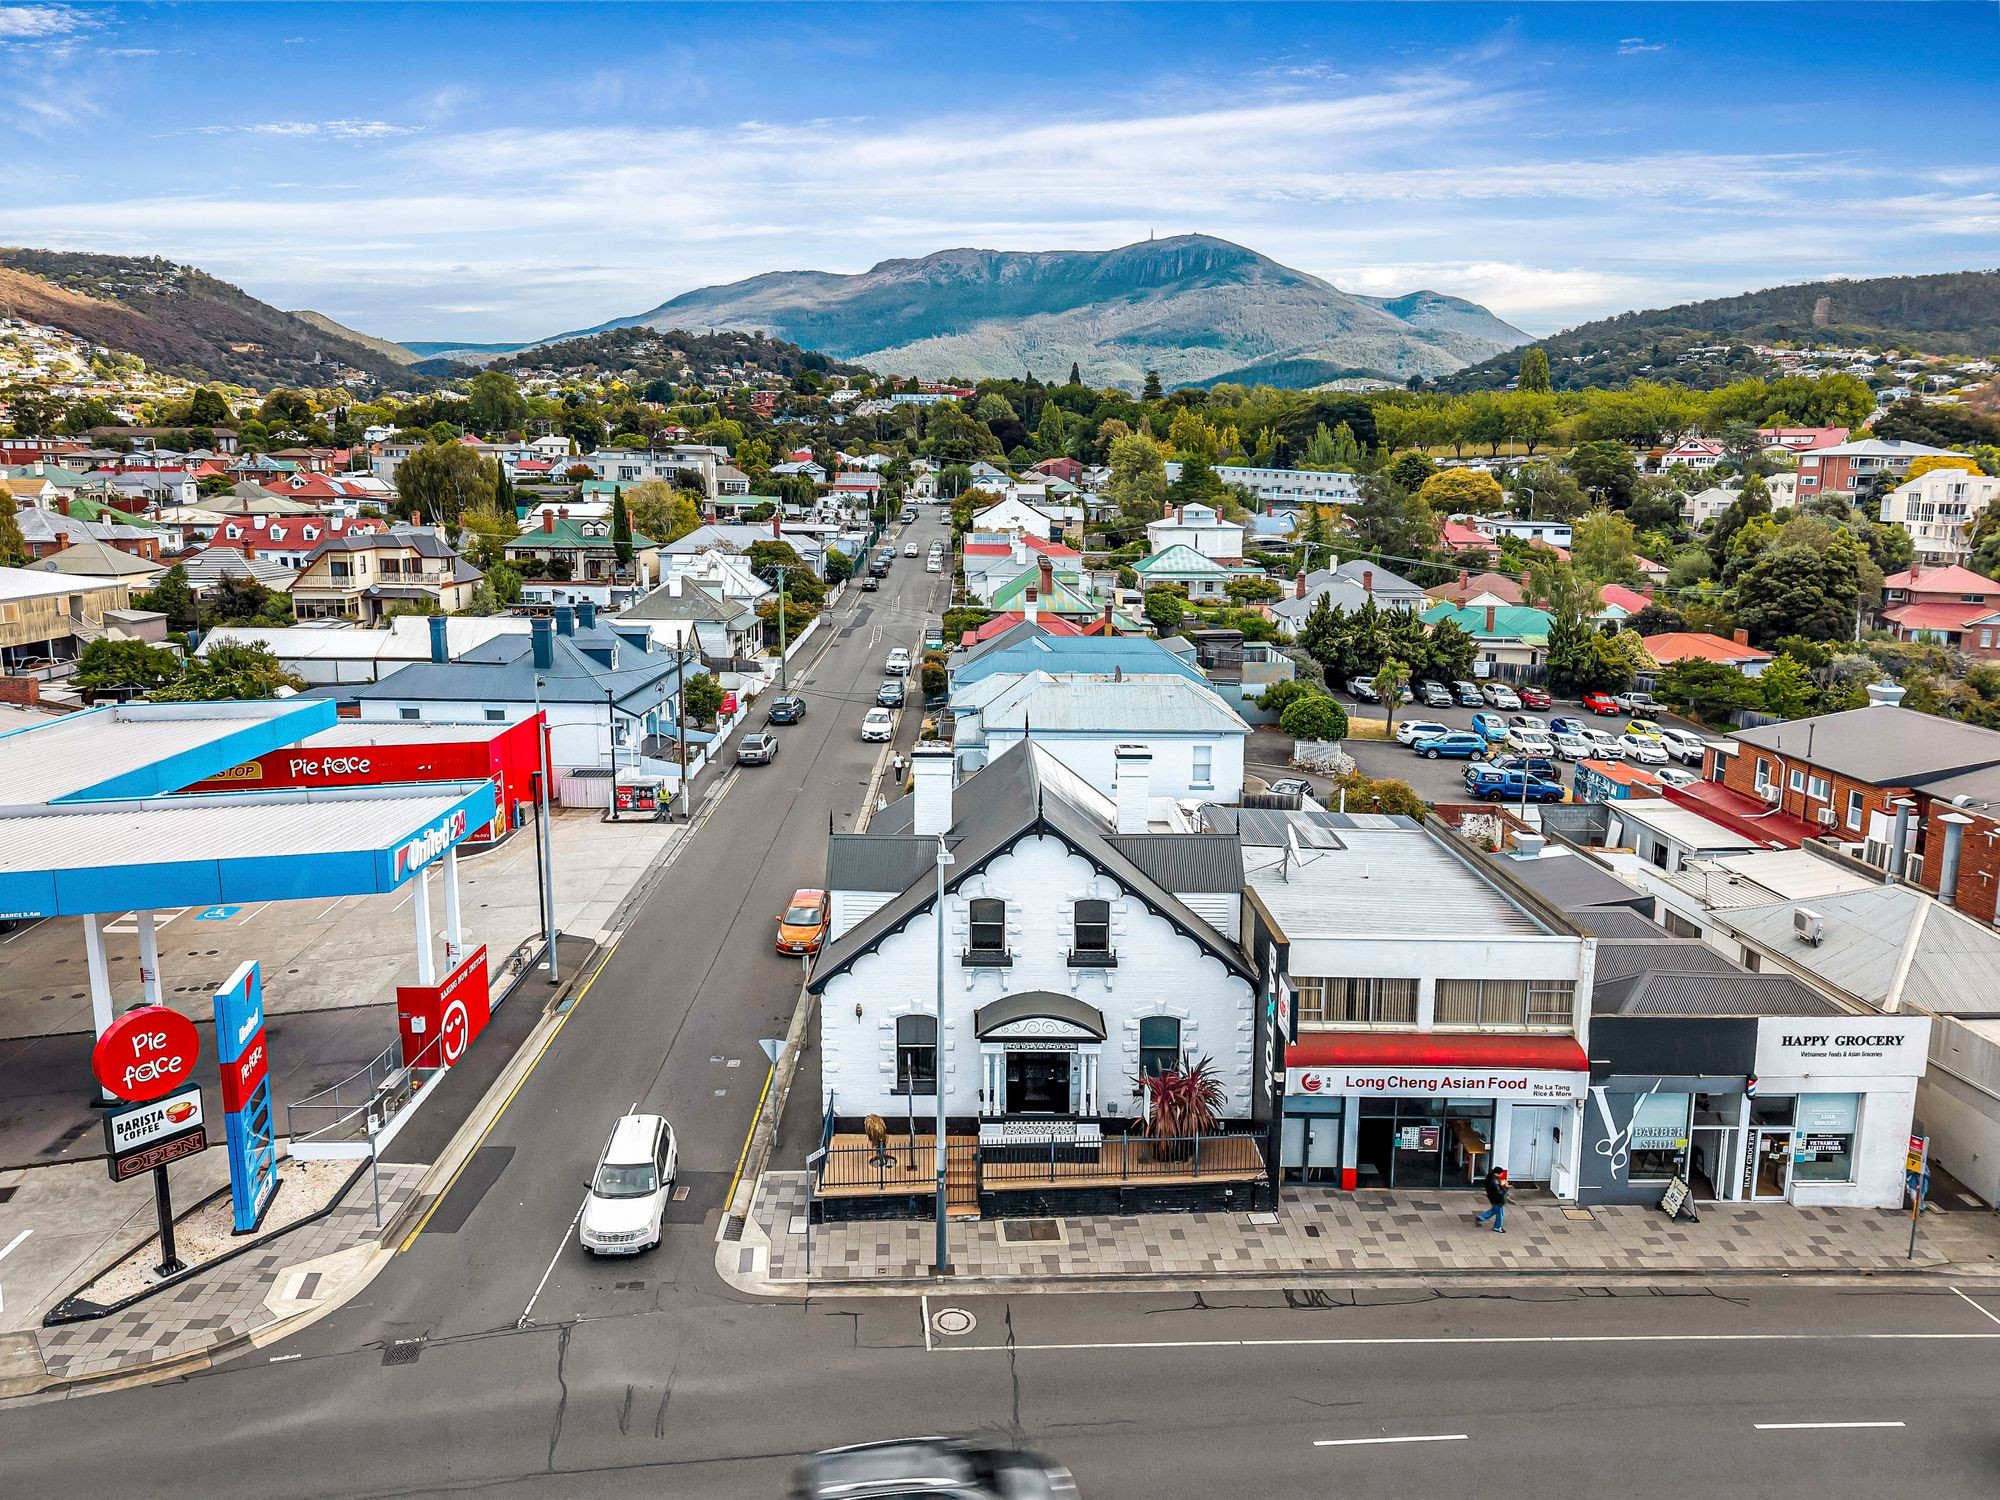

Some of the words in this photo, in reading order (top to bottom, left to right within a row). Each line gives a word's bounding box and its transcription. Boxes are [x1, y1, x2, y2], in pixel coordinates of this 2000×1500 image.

[407, 818, 450, 871] United
[450, 808, 466, 841] 24
[1264, 941, 1278, 1100] BAXTON
[1781, 1035, 1830, 1046] HAPPY
[1834, 1035, 1905, 1046] GROCERY
[122, 1056, 182, 1090] face
[1345, 1075, 1385, 1091] Long
[1387, 1075, 1438, 1092] Cheng
[1440, 1076, 1485, 1089] Asian
[1488, 1076, 1528, 1090] Food
[116, 1109, 165, 1135] BARISTA
[123, 1122, 160, 1141] COFFEE
[1634, 1127, 1685, 1137] BARBER
[121, 1135, 200, 1173] OPEN
[1641, 1140, 1676, 1149] SHOP
[1745, 1131, 1756, 1164] GROCERY
[1743, 1163, 1752, 1188] HAPPY
